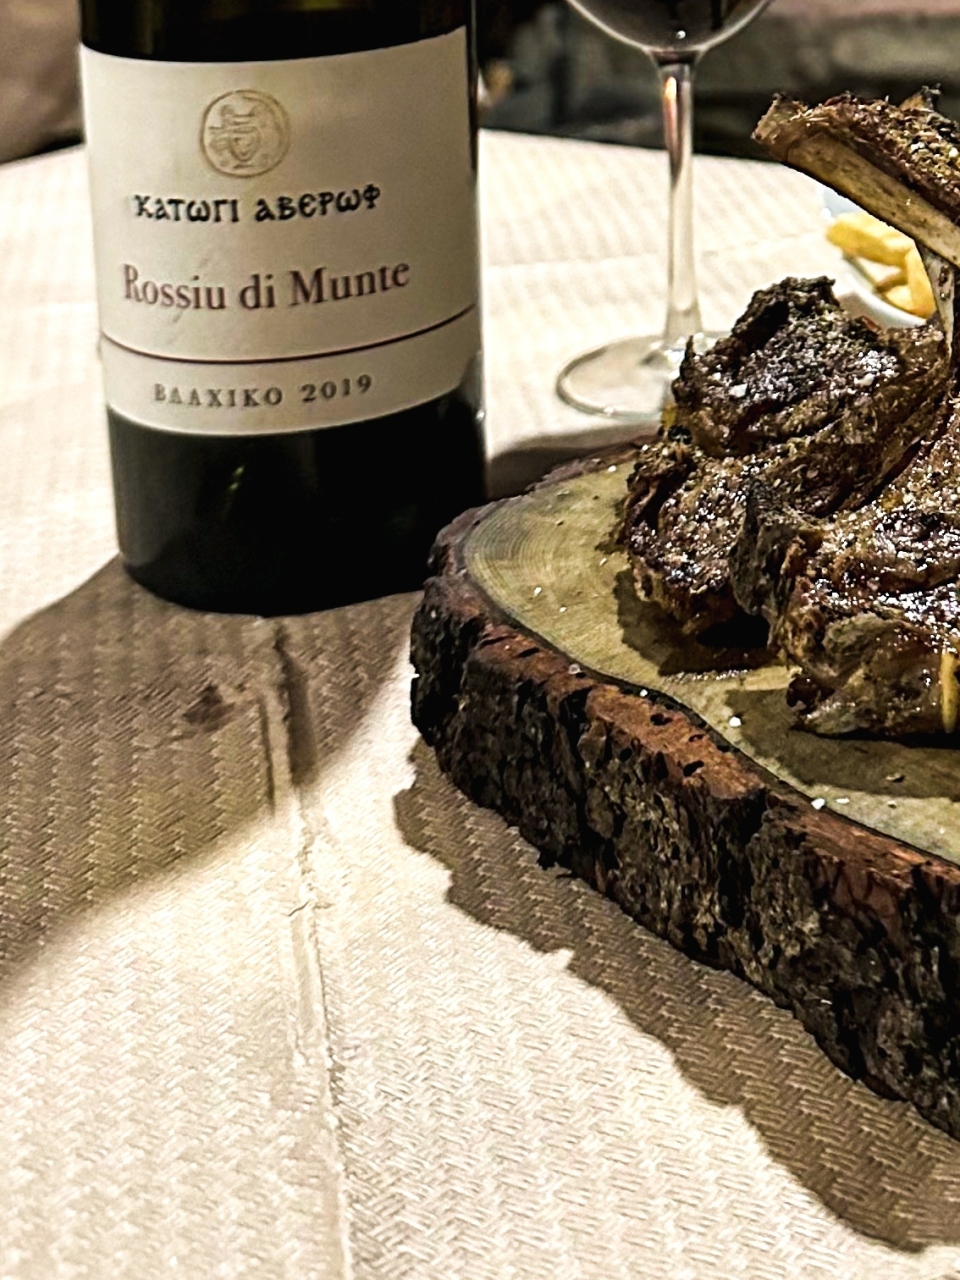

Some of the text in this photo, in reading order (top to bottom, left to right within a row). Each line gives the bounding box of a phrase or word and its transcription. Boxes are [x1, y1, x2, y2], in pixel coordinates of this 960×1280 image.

[123, 262, 411, 311] Rossiu di Munte
[152, 373, 373, 408] ΒΛΑΧΙΚΟ 2019
